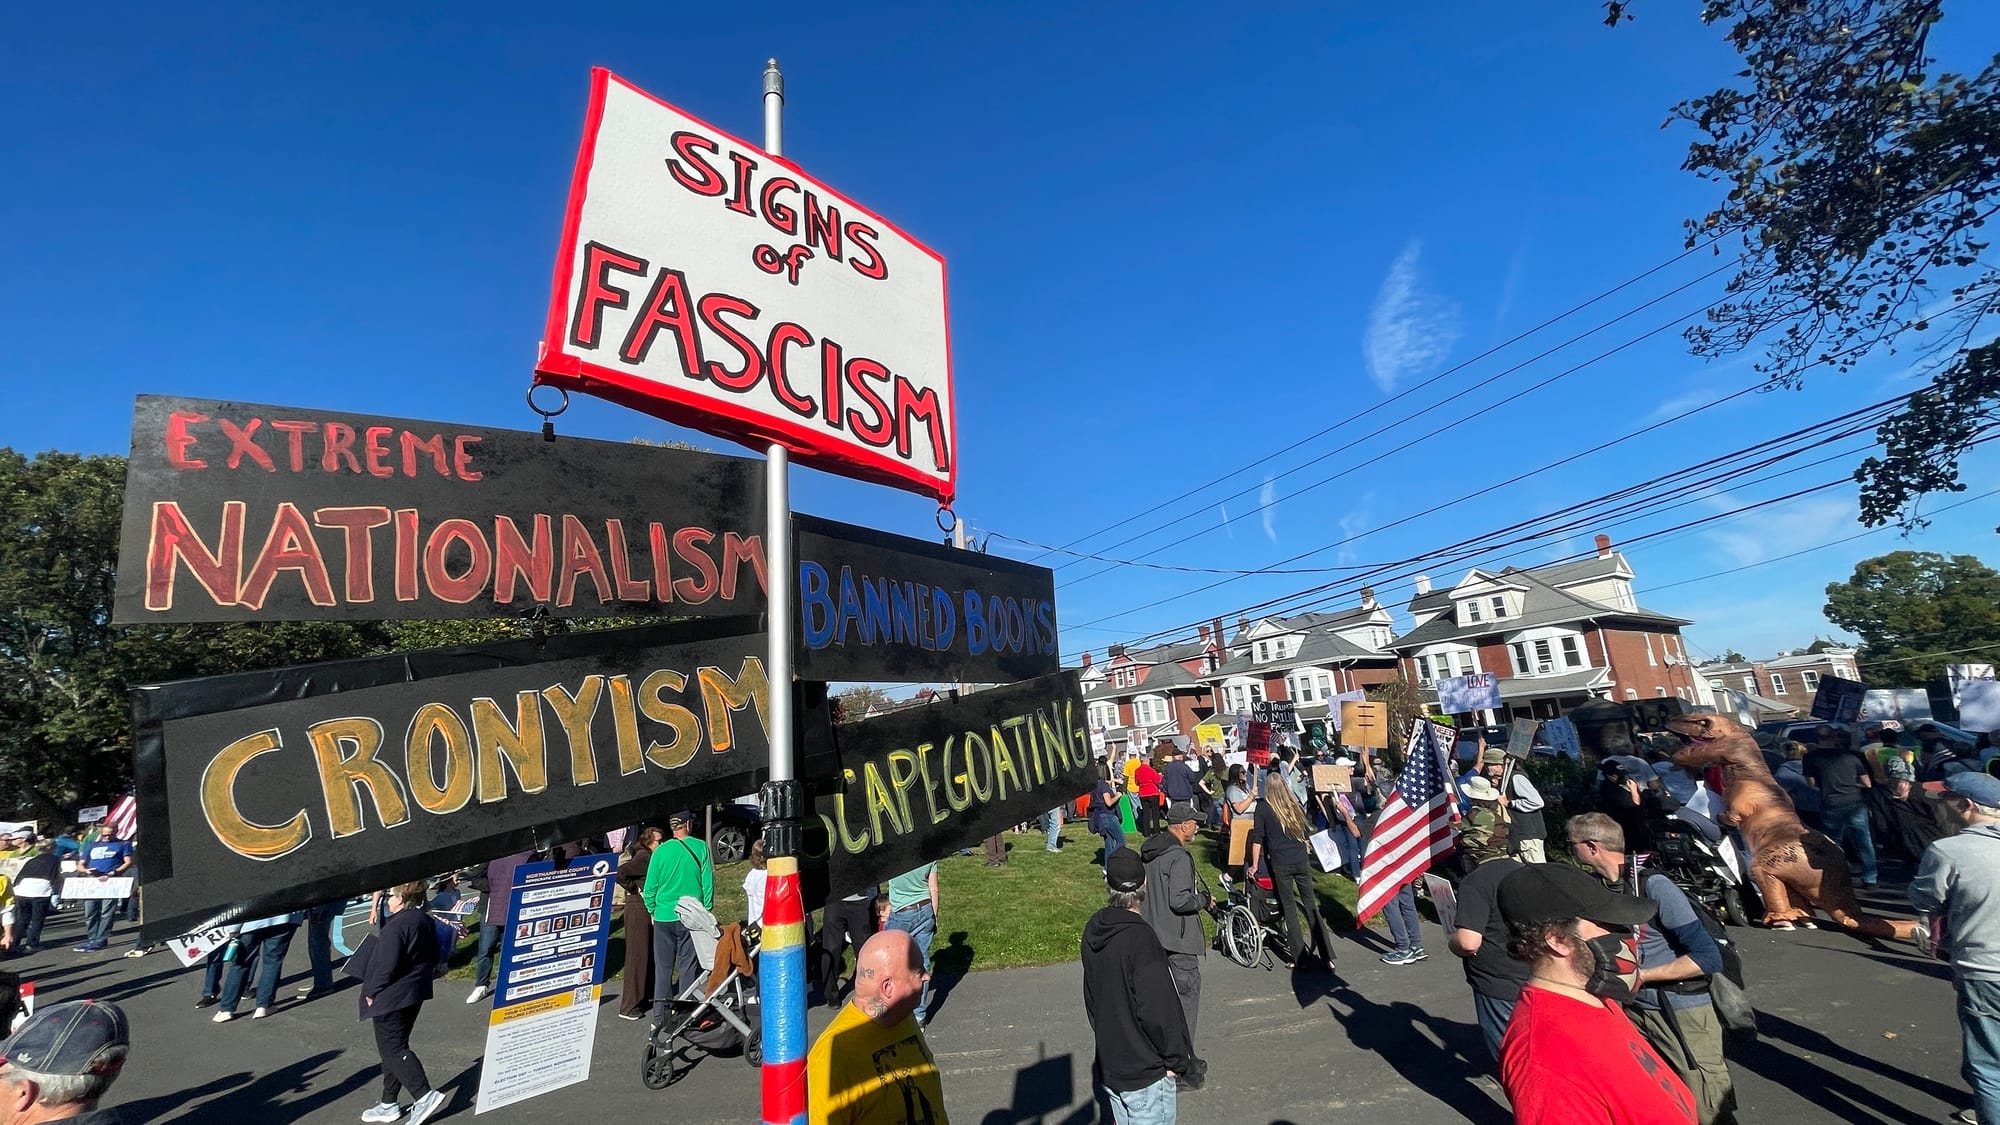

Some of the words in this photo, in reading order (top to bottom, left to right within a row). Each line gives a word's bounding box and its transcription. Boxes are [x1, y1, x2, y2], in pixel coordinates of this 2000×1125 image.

[665, 130, 888, 280] SIGNS
[752, 243, 815, 285] of
[569, 240, 950, 473] FASCISM
[165, 411, 483, 482] EXTREME
[143, 500, 769, 610] NATIONALISM
[799, 560, 957, 652] BANNED
[964, 588, 1055, 657] BOOKS
[1252, 702, 1266, 712] NO
[1255, 713, 1268, 723] NO
[1467, 673, 1490, 689] LOVE
[201, 655, 770, 861] CRONYISM
